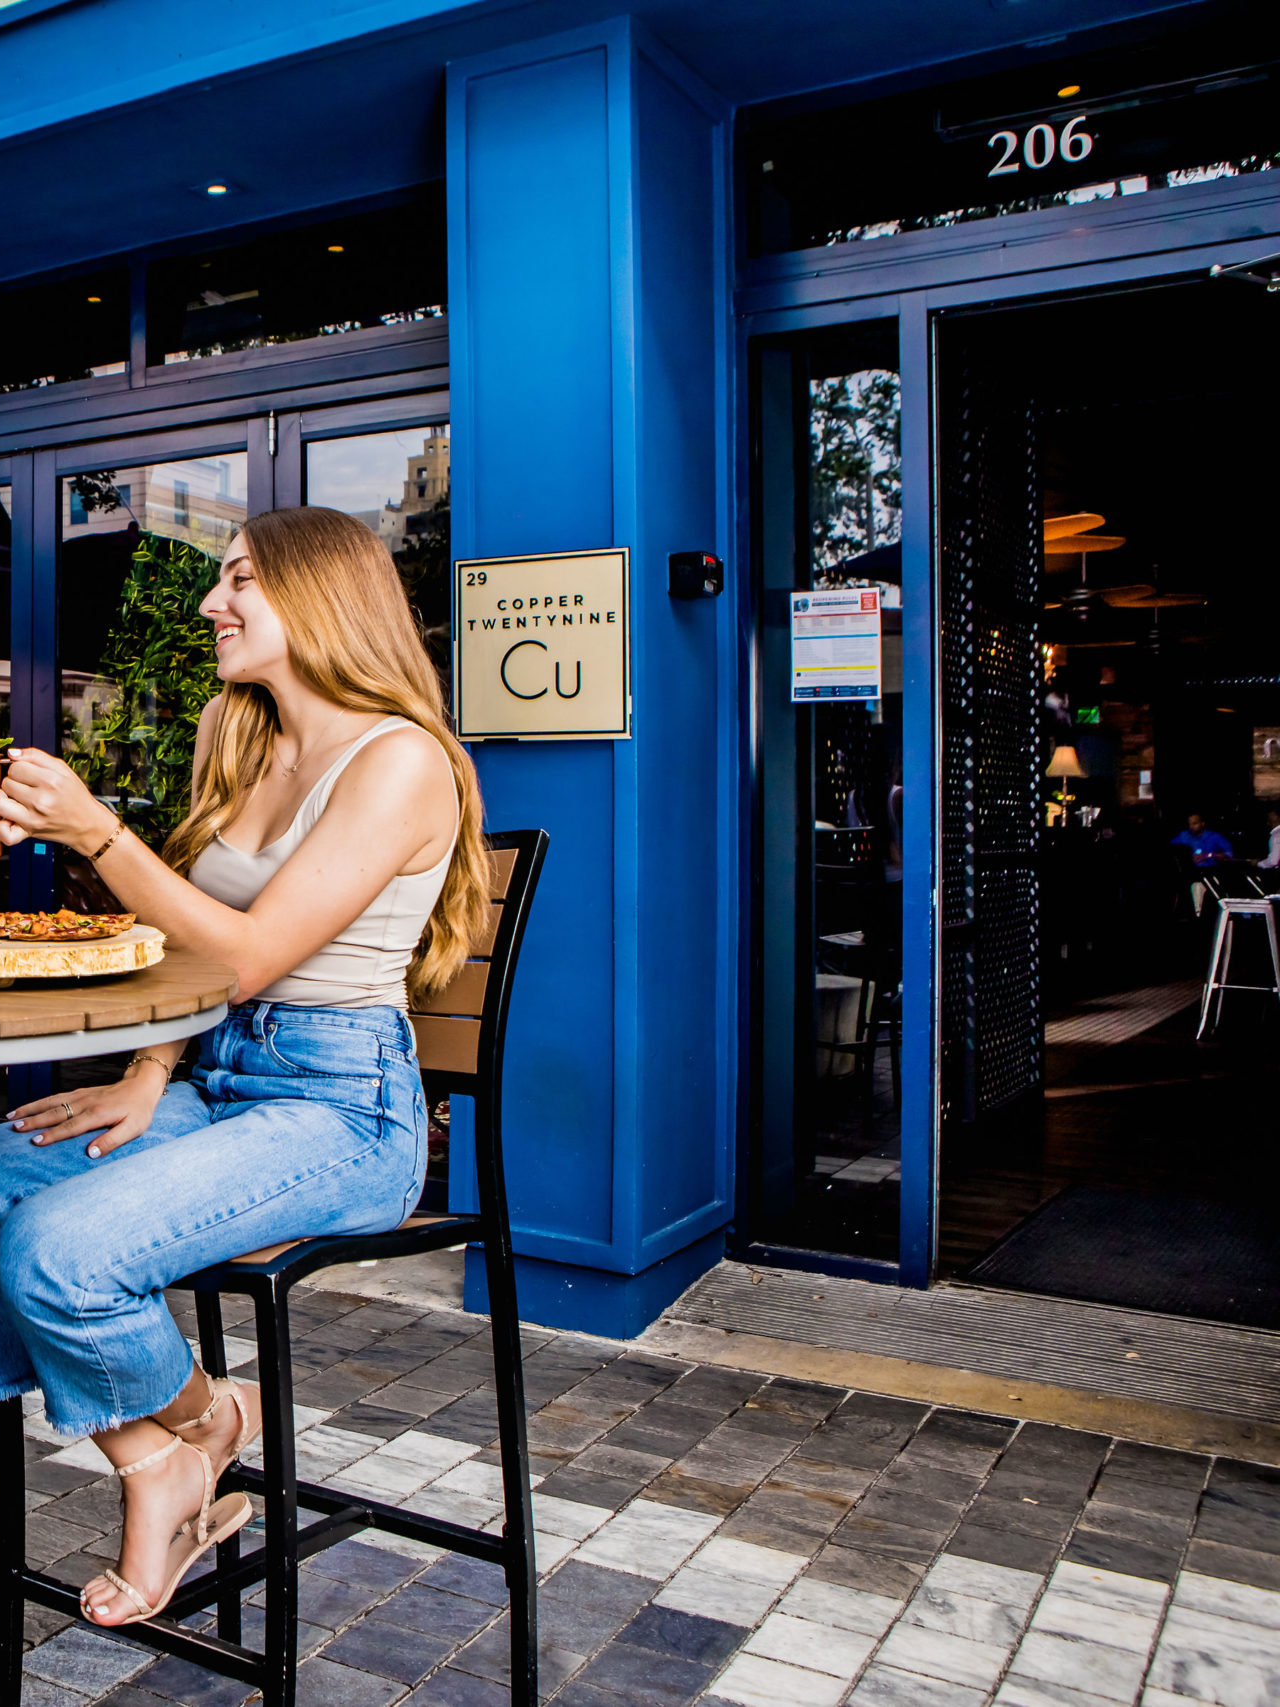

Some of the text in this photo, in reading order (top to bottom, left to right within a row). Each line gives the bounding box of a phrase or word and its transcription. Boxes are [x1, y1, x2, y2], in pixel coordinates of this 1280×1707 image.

[987, 115, 1094, 178] 206
[466, 571, 488, 586] 29
[497, 594, 584, 611] COPPER
[467, 611, 616, 631] TWENTYNINE
[500, 639, 581, 700] Cu
